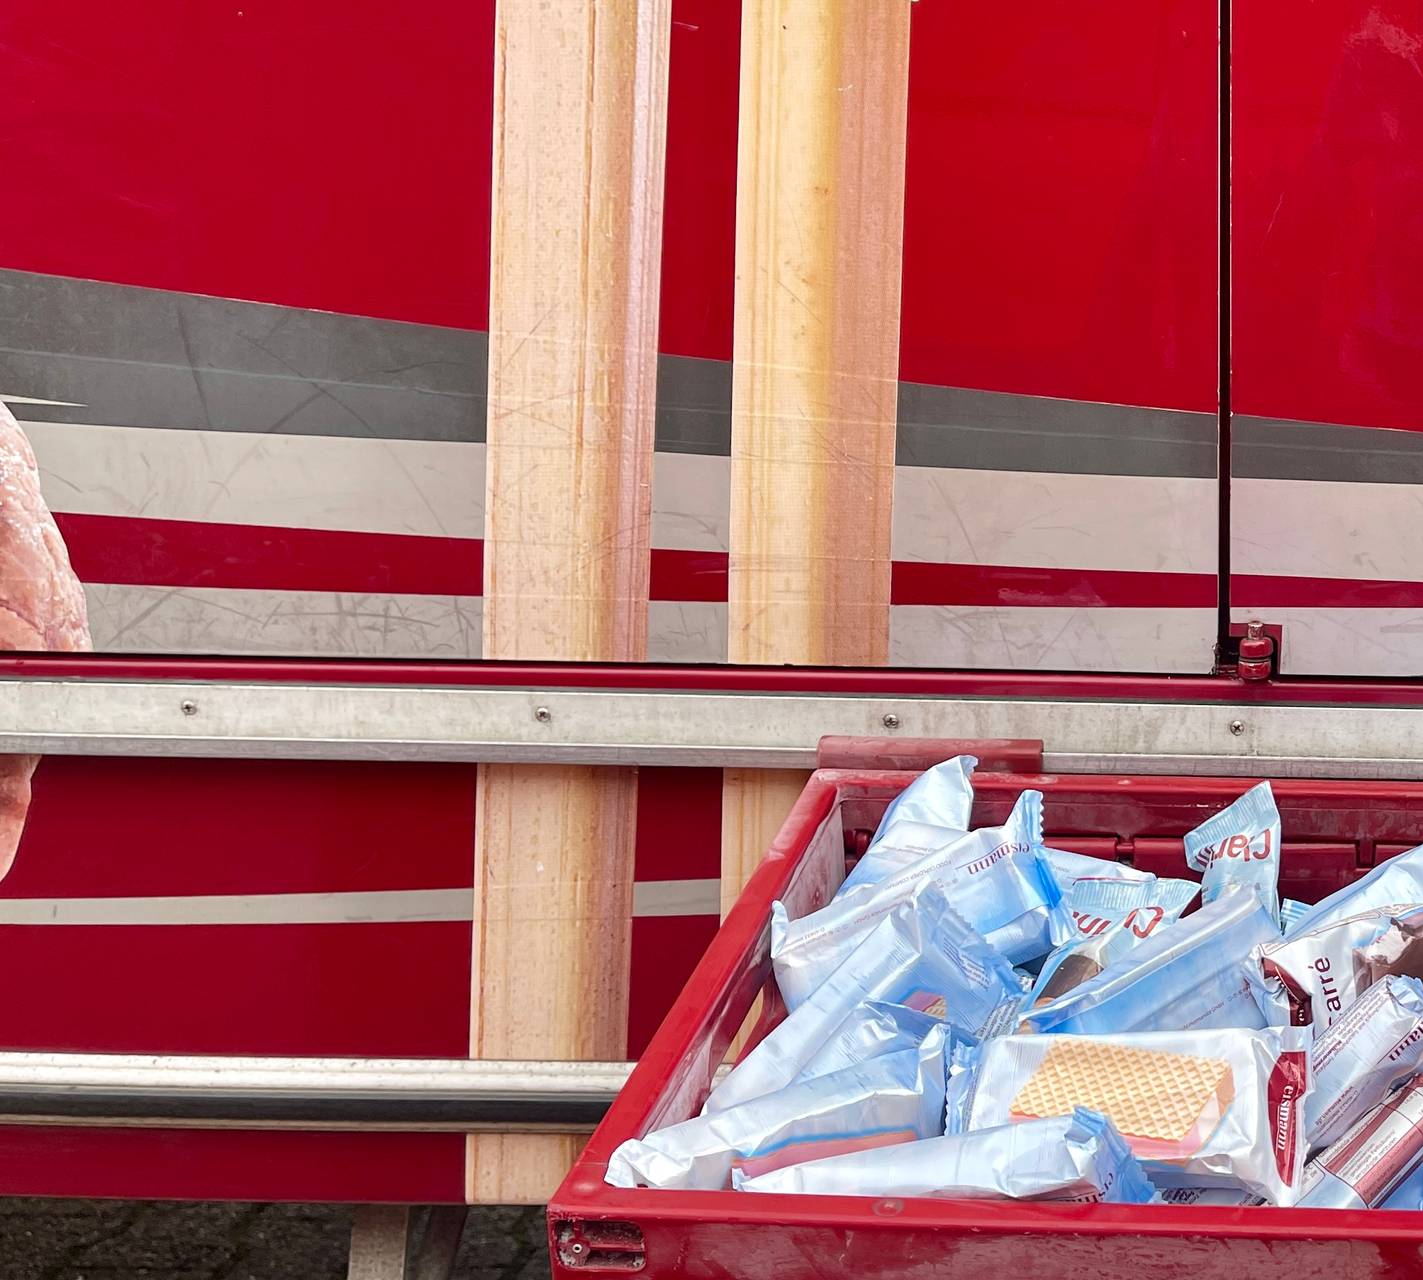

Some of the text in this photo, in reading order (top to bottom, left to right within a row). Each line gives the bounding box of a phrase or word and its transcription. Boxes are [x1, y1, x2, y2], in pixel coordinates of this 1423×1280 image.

[967, 842, 1030, 876] eismann
[1308, 957, 1342, 1026] arré
[1277, 1085, 1294, 1151] eismann
